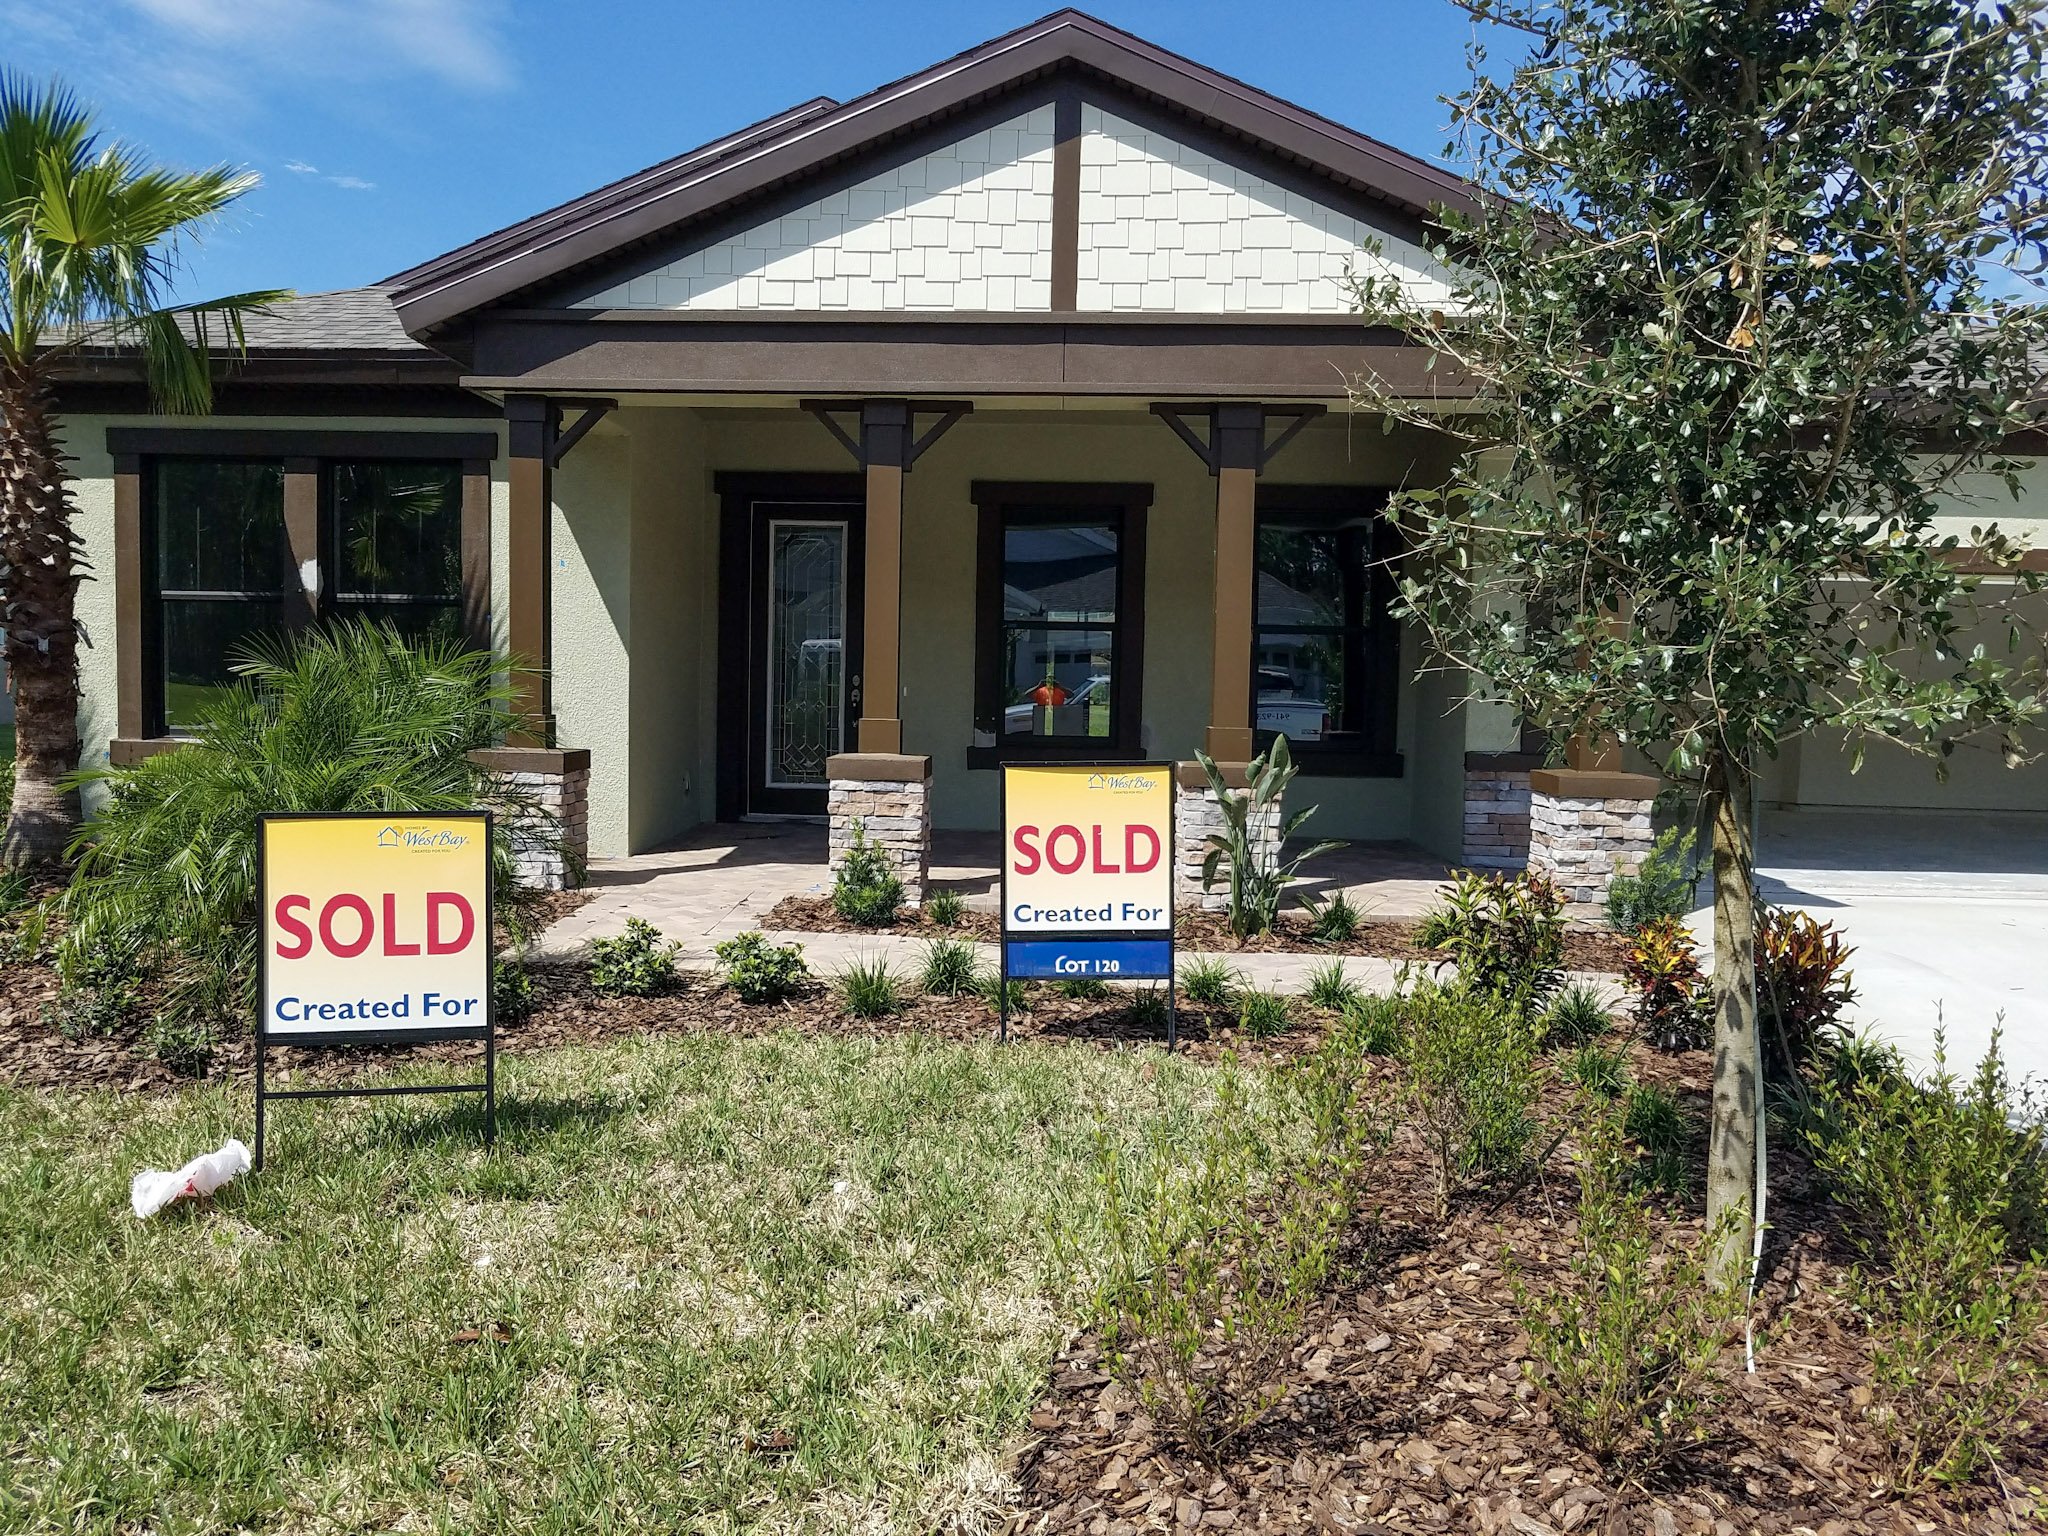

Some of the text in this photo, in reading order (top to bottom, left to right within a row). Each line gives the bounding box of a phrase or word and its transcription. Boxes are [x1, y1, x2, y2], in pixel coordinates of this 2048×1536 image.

[1108, 776, 1156, 791] West Bay
[403, 830, 467, 850] West Bay
[1013, 824, 1161, 875] SOLD
[1013, 902, 1163, 922] Created For
[275, 892, 475, 960] SOLD
[1095, 959, 1120, 973] 120
[275, 992, 478, 1021] Created For
